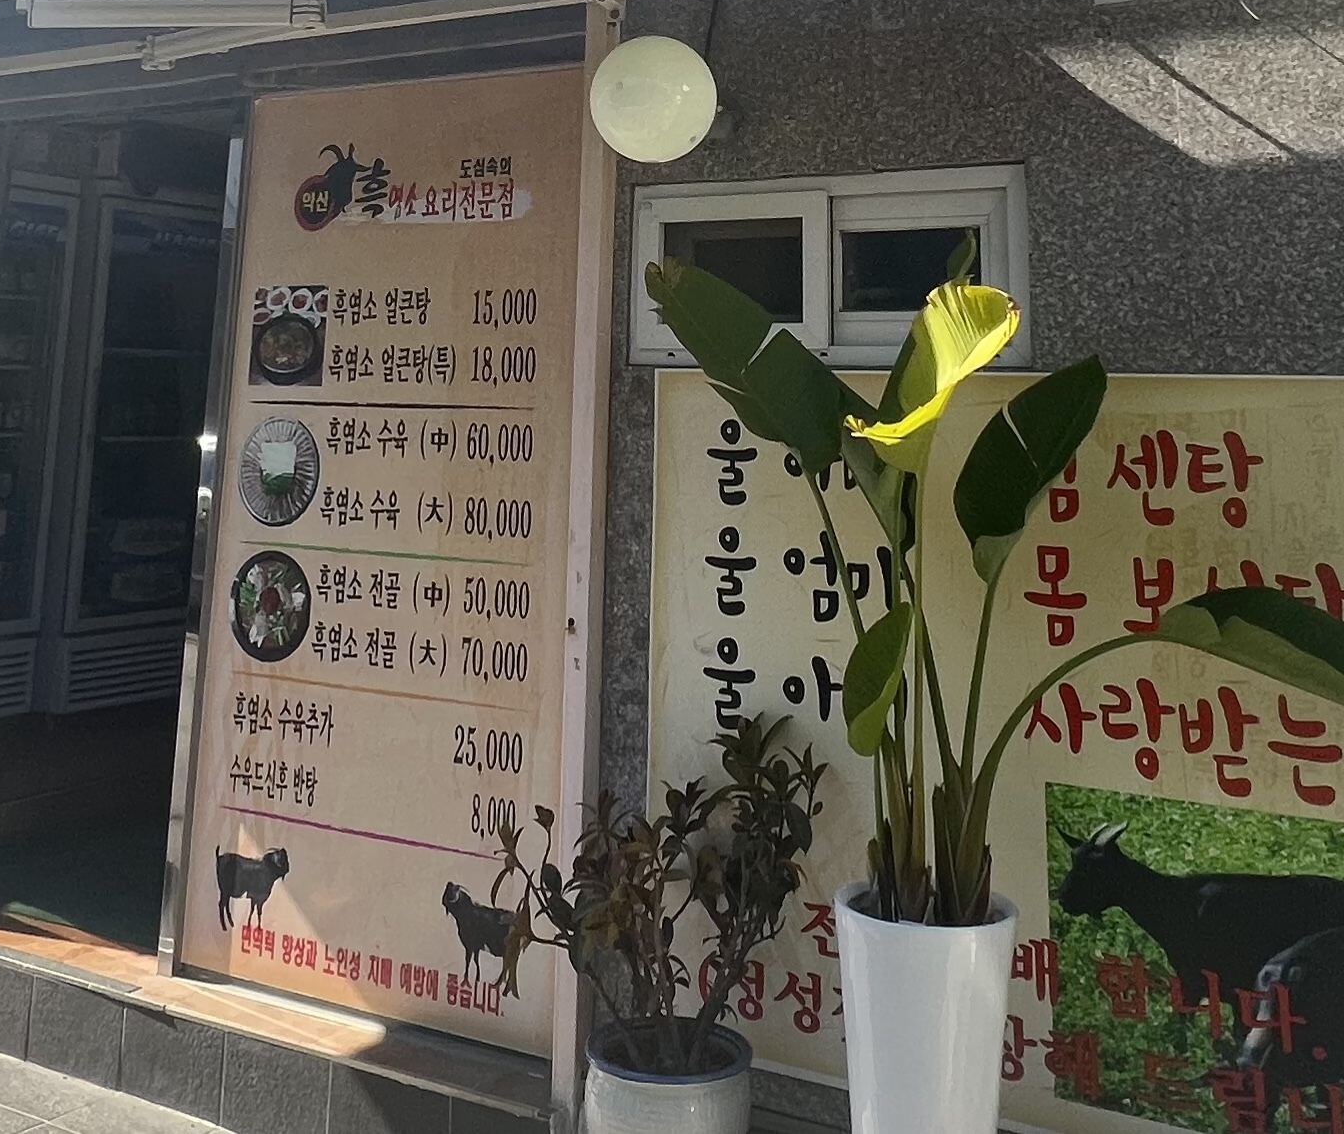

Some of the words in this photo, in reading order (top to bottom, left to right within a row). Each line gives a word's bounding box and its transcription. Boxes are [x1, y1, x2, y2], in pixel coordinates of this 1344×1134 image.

[459, 156, 513, 179] 도심속의
[332, 289, 378, 325] 흑염소
[384, 287, 432, 326] 얼큰탕
[471, 287, 538, 330] 15,000
[329, 344, 375, 383] 흑염소
[470, 345, 537, 388] 18,000
[326, 416, 372, 455] 흑염소
[376, 417, 409, 459] 수육
[466, 422, 534, 465] 60,000
[707, 418, 758, 505] 울
[320, 486, 364, 527] 흑염소
[370, 489, 401, 531] 수육
[464, 496, 533, 541] 80,000
[1106, 429, 1264, 529] 센탕
[316, 564, 363, 604] 흑염소
[368, 568, 401, 611] 전골
[462, 576, 531, 620] 50,000
[704, 526, 757, 616] 울
[1023, 545, 1088, 647] 몸
[311, 621, 358, 664] 흑염소
[364, 626, 398, 670] 전골
[460, 636, 529, 683] 70,000
[703, 636, 756, 730] 울
[233, 691, 273, 735] 흑염소
[277, 698, 335, 748] 수육추가
[453, 724, 523, 775] 25,000
[292, 764, 319, 807] 반탕
[471, 793, 517, 840] 8,000
[241, 923, 276, 961] 면역력
[281, 934, 318, 971] 향상과
[322, 944, 361, 982] 노인성
[400, 962, 440, 1002] 예방에
